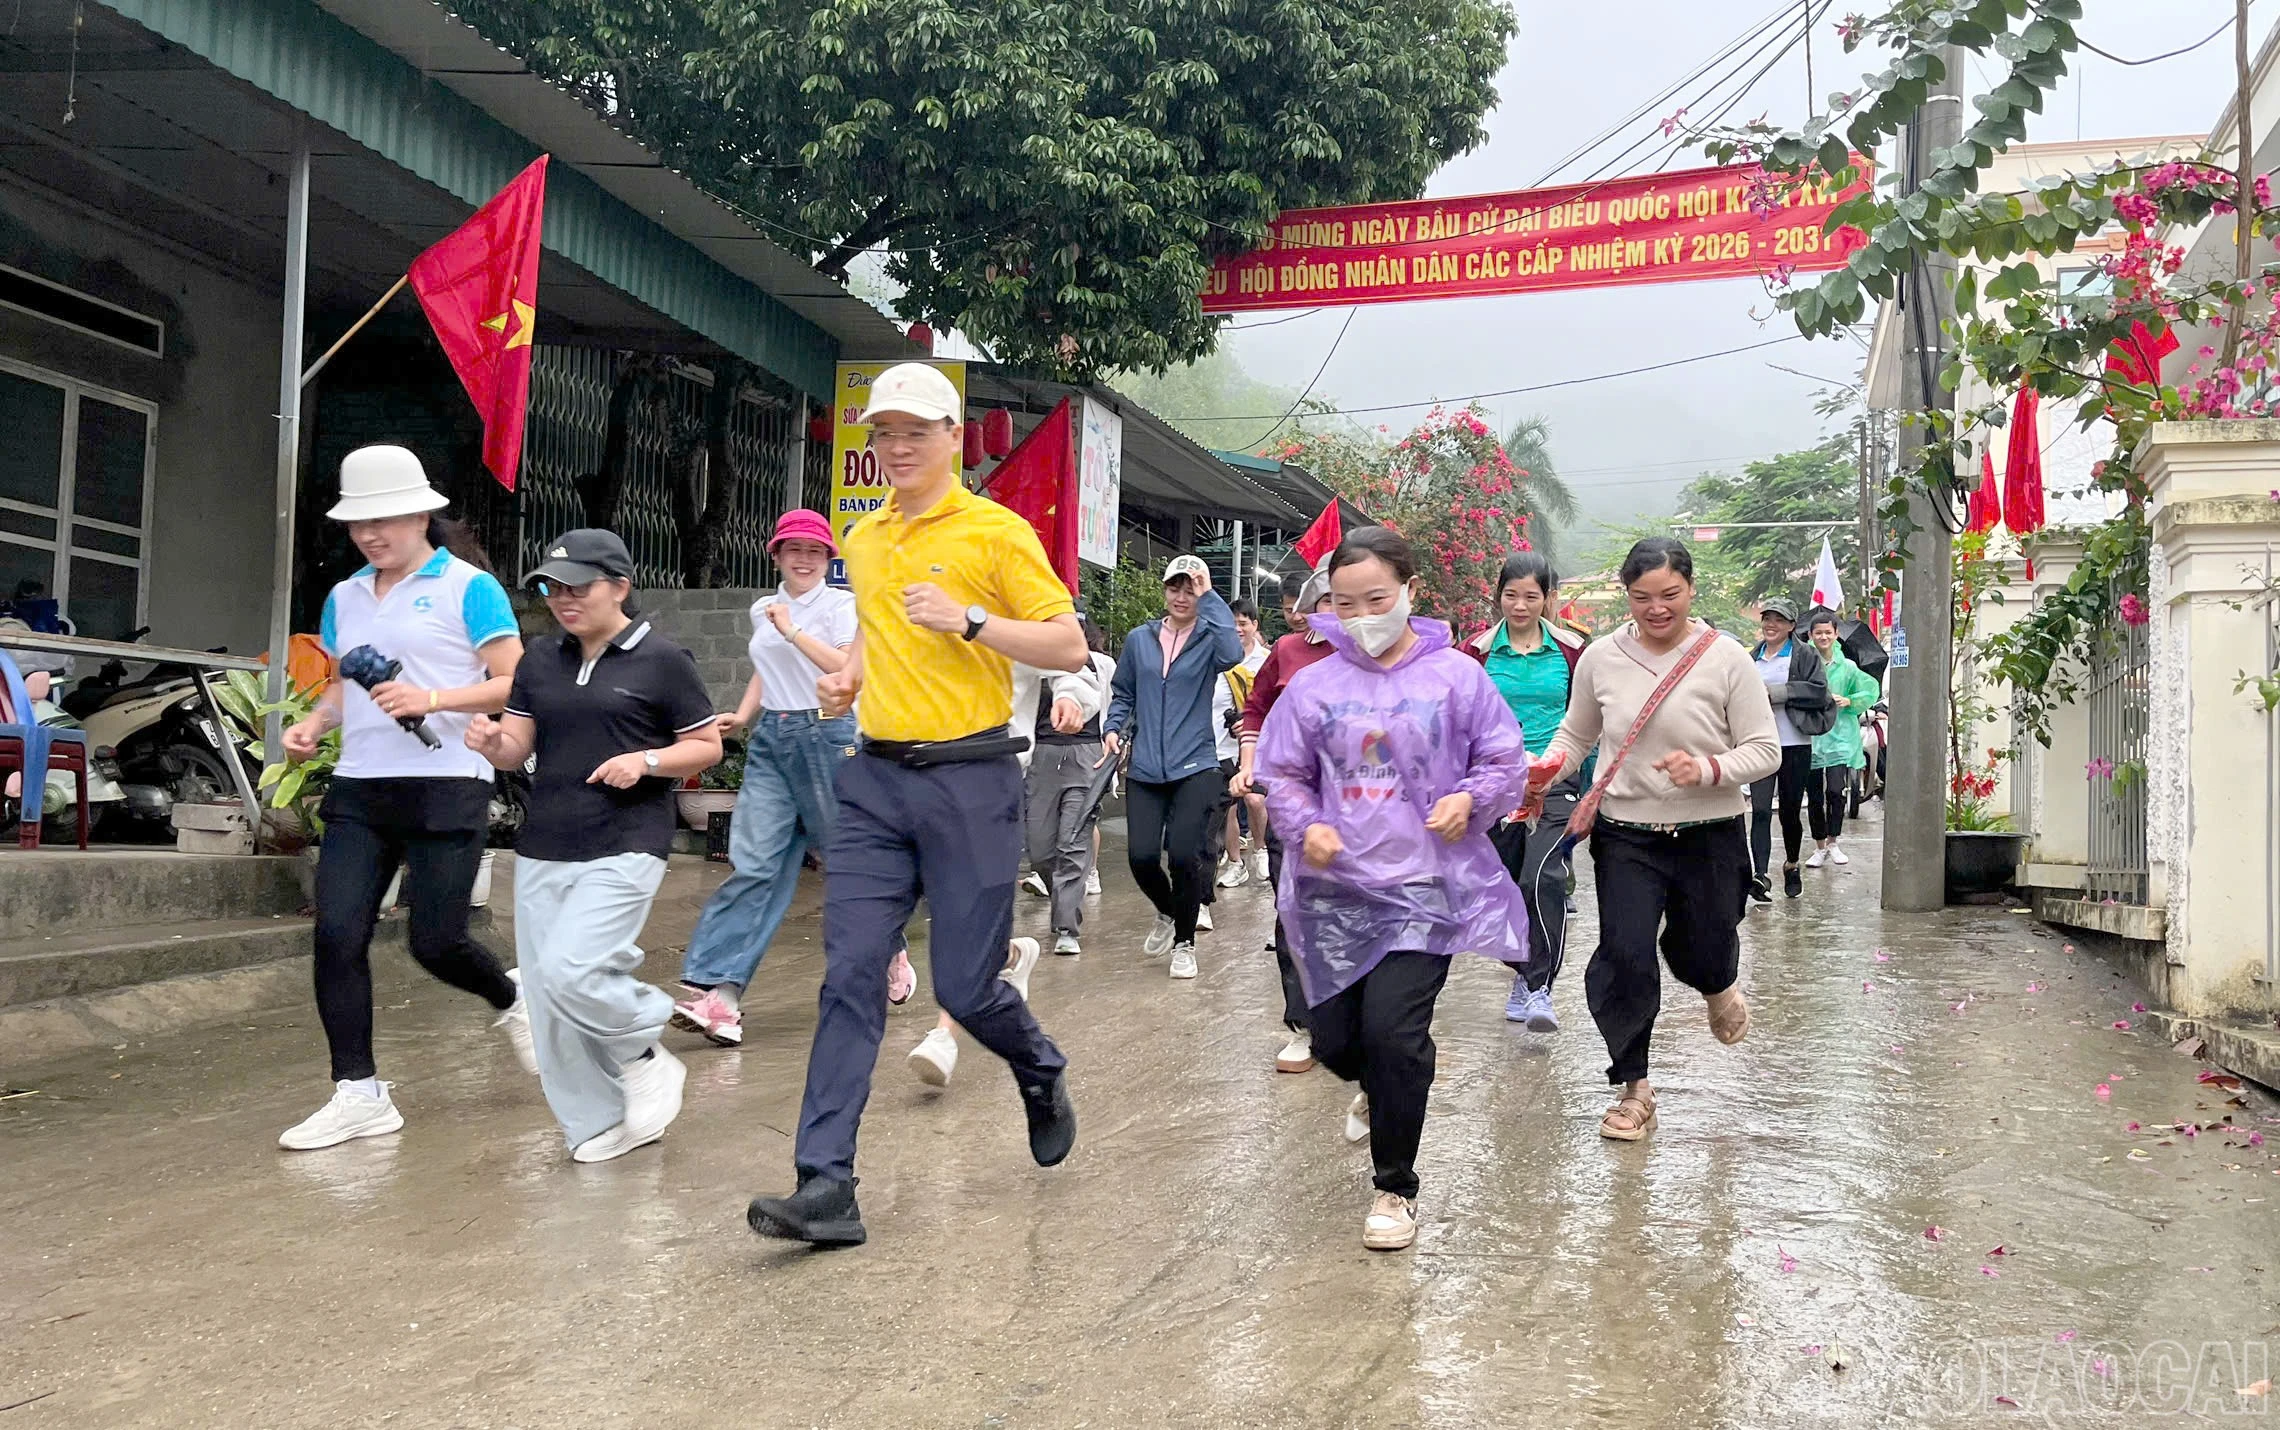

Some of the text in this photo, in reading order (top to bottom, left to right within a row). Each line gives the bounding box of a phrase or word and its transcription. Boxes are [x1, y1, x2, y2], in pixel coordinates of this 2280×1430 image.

[1281, 219, 1345, 250] MỪNG
[1352, 213, 1410, 246] NGÀY
[1416, 206, 1460, 242] BẦU
[1467, 201, 1500, 238] CỬ
[1503, 206, 1542, 239] ĐẠI
[1549, 194, 1600, 229] BIỂU
[1607, 186, 1670, 226] QUỐC
[1678, 184, 1718, 223] HỘI
[1240, 262, 1275, 298] HỘI
[1280, 256, 1339, 292] ĐỒNG
[1345, 254, 1404, 288] NHÂN
[1413, 251, 1458, 284] DÂN
[1465, 246, 1510, 279] CÁC
[1517, 238, 1563, 275] CẤP
[1570, 237, 1647, 275] NHIỆM
[1654, 231, 1686, 265] KỲ
[1691, 233, 1750, 262] 2026
